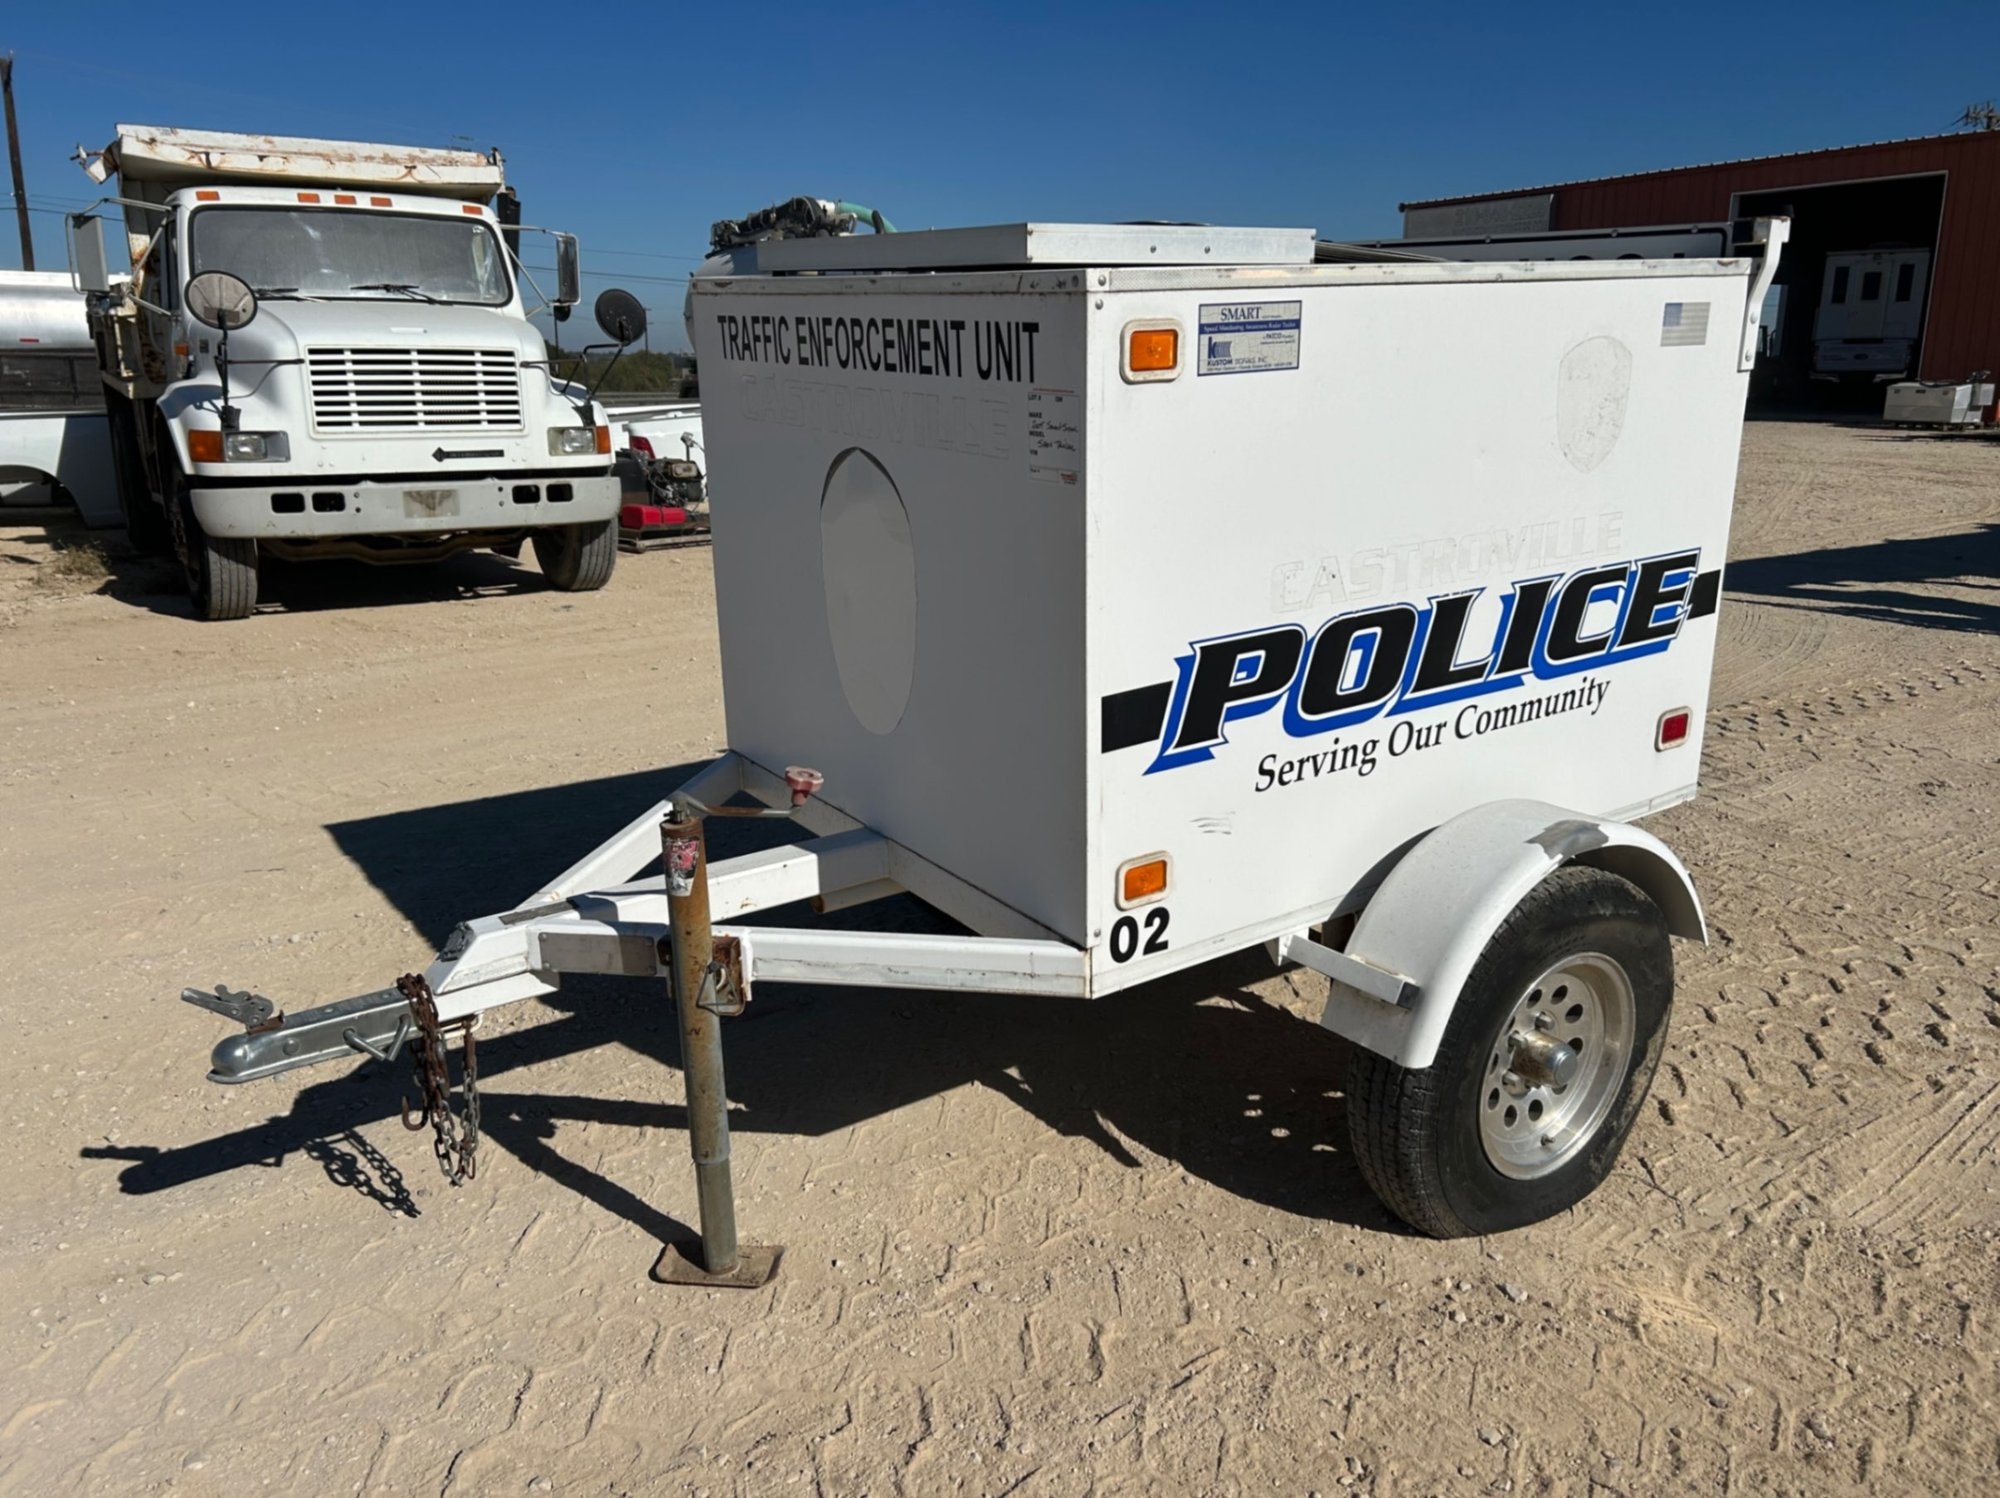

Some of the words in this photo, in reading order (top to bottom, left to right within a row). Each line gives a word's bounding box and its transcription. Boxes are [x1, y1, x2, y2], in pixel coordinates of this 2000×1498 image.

[717, 315, 791, 365] TRAFFIC
[795, 316, 966, 378] ENFORCEMENT
[974, 320, 1039, 384] UNIT
[1220, 306, 1262, 321] SMART
[1269, 511, 1624, 616] CASTROVILLE
[1142, 548, 1701, 775] POLICE
[1254, 735, 1379, 793] Serving
[1387, 718, 1447, 758] Our
[1453, 674, 1612, 741] Community
[1109, 906, 1170, 964] 02
